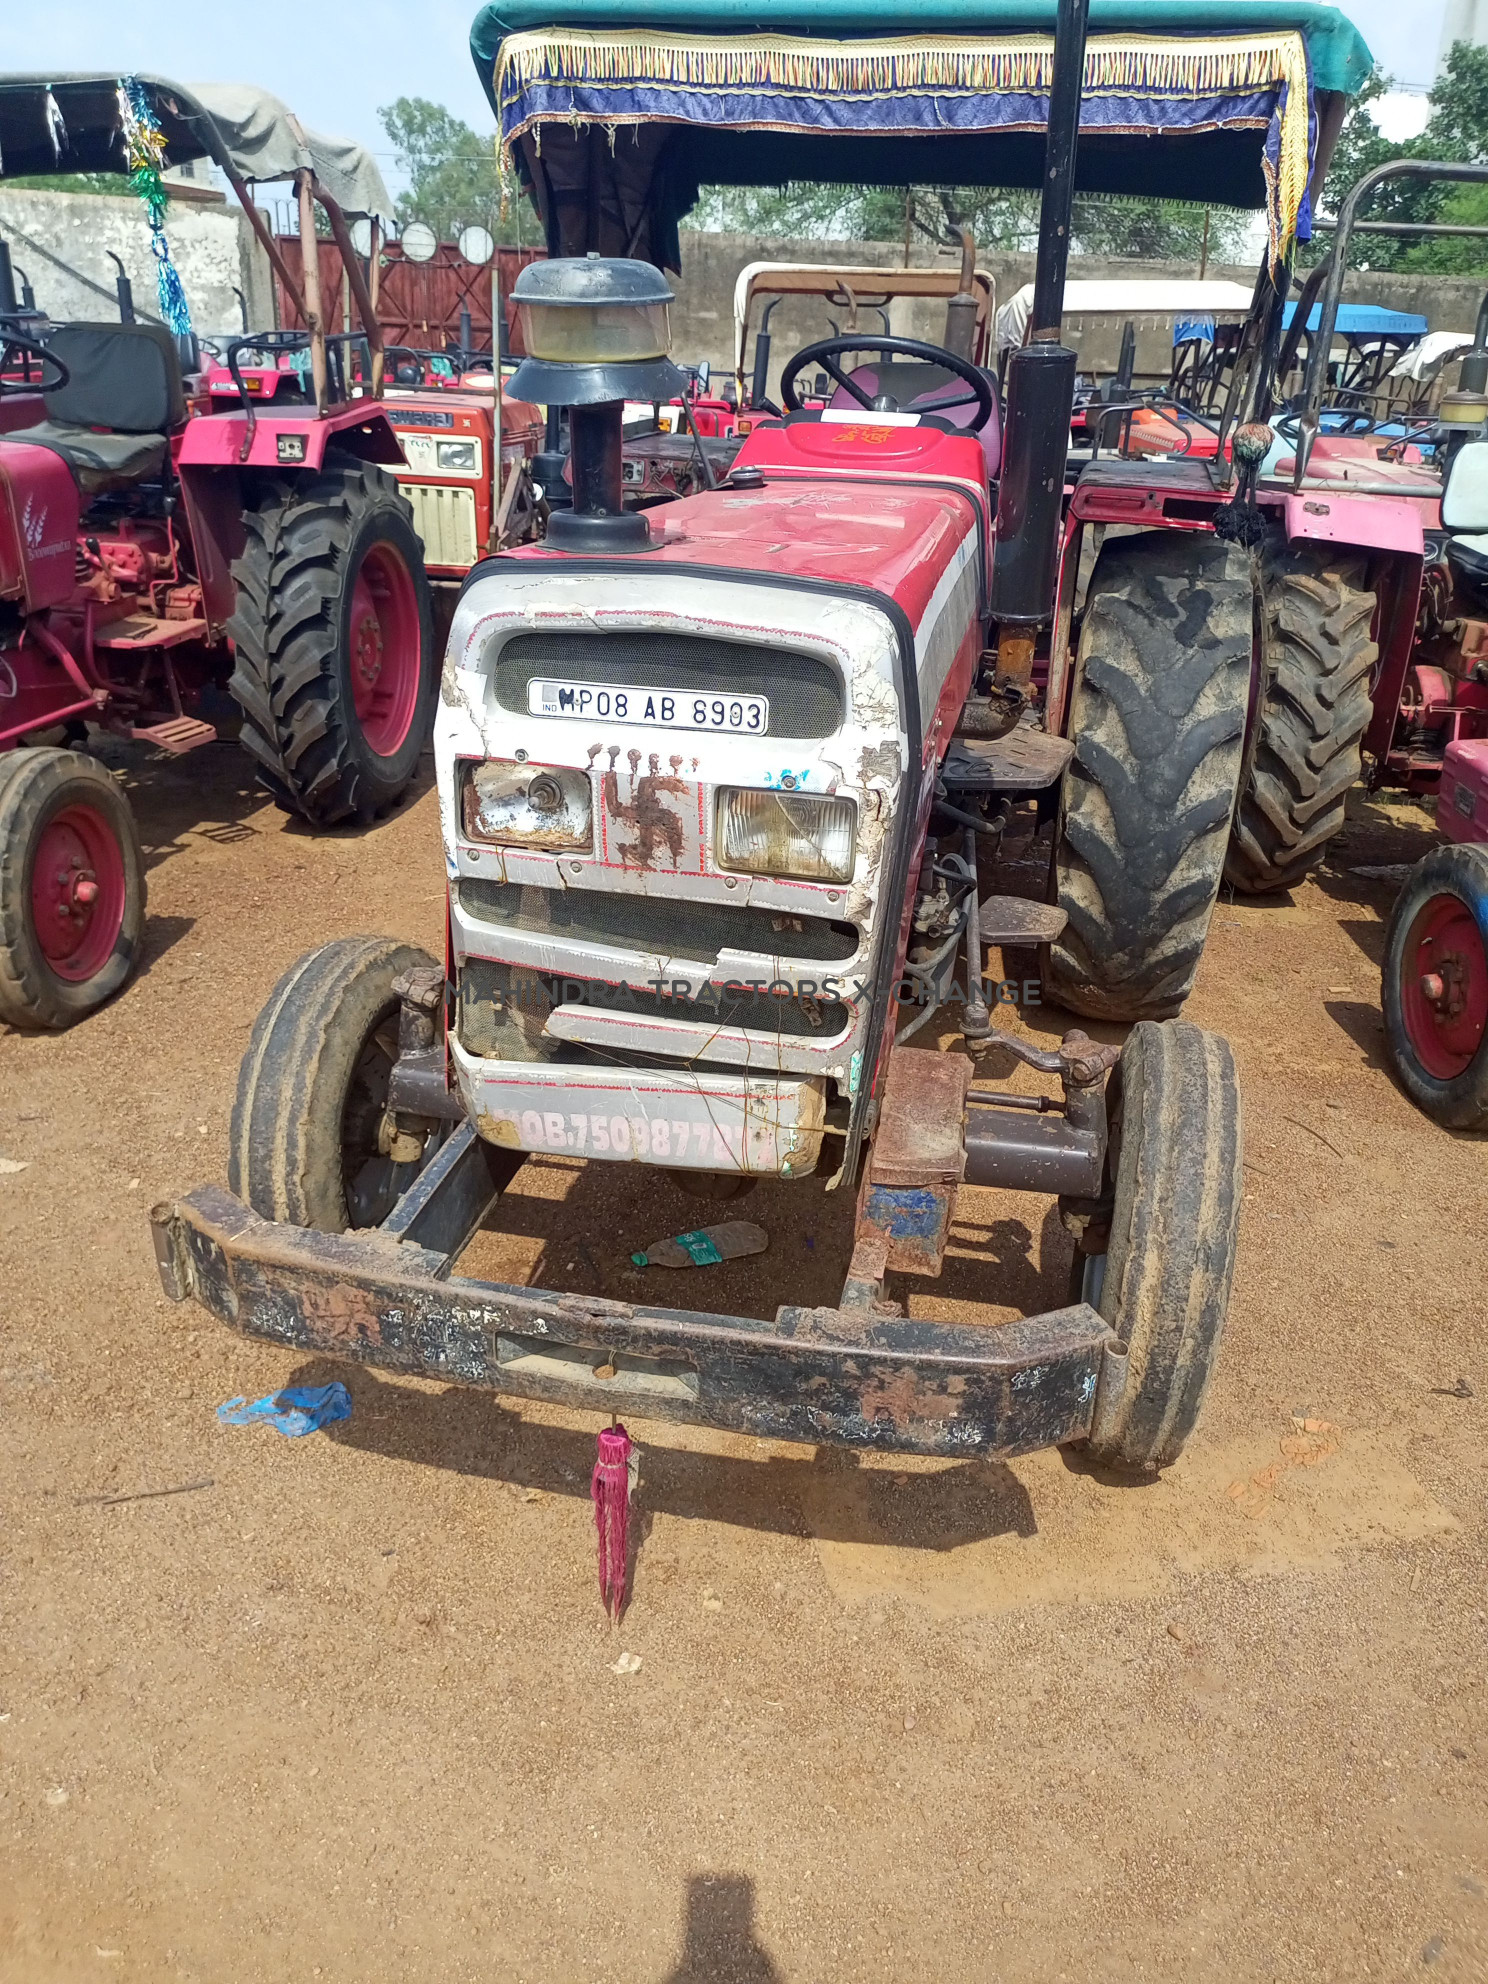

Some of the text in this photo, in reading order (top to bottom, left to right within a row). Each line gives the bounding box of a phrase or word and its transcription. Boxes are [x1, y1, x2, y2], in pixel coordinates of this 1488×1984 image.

[543, 703, 557, 712] IND
[559, 688, 761, 729] MP08 AB 8903
